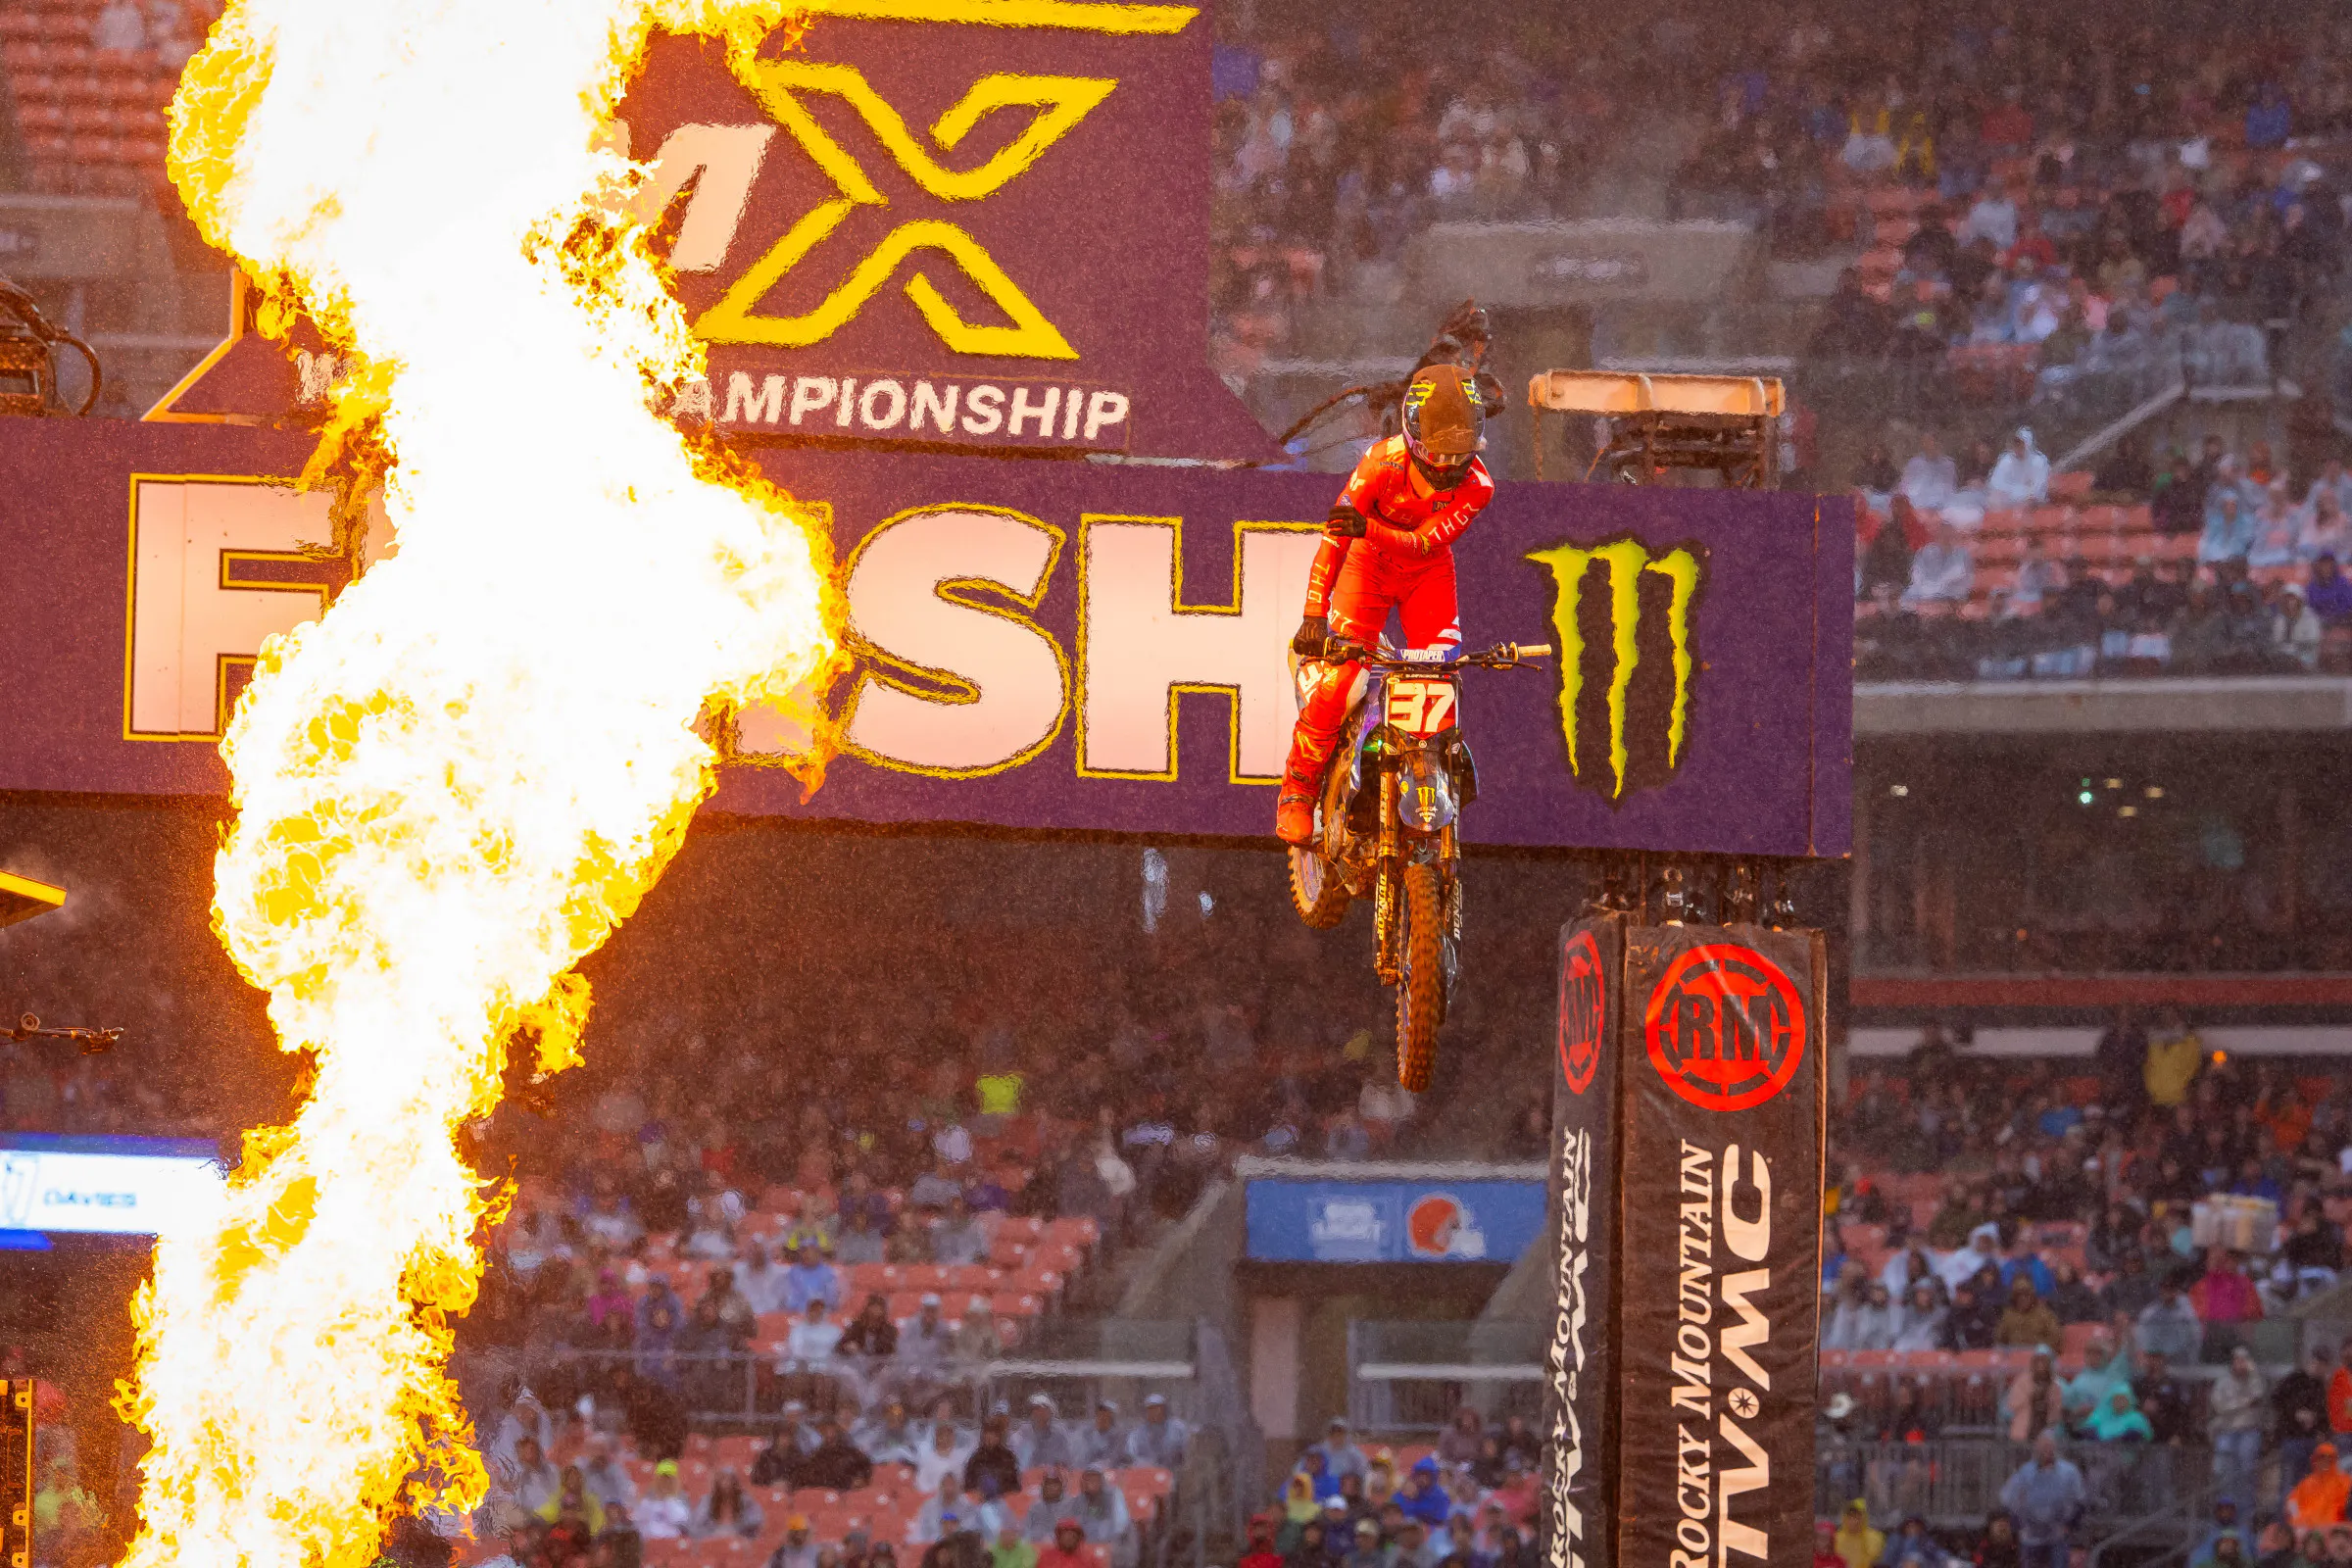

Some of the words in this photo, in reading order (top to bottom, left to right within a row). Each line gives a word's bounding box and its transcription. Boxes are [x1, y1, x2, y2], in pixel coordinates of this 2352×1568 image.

[647, 370, 1129, 440] AMPIONSHIP
[1403, 650, 1443, 661] PROTAPER
[1388, 682, 1455, 733] 37
[1377, 872, 1388, 941] DUNLOP
[1671, 1138, 1713, 1421] MOUNTAIN
